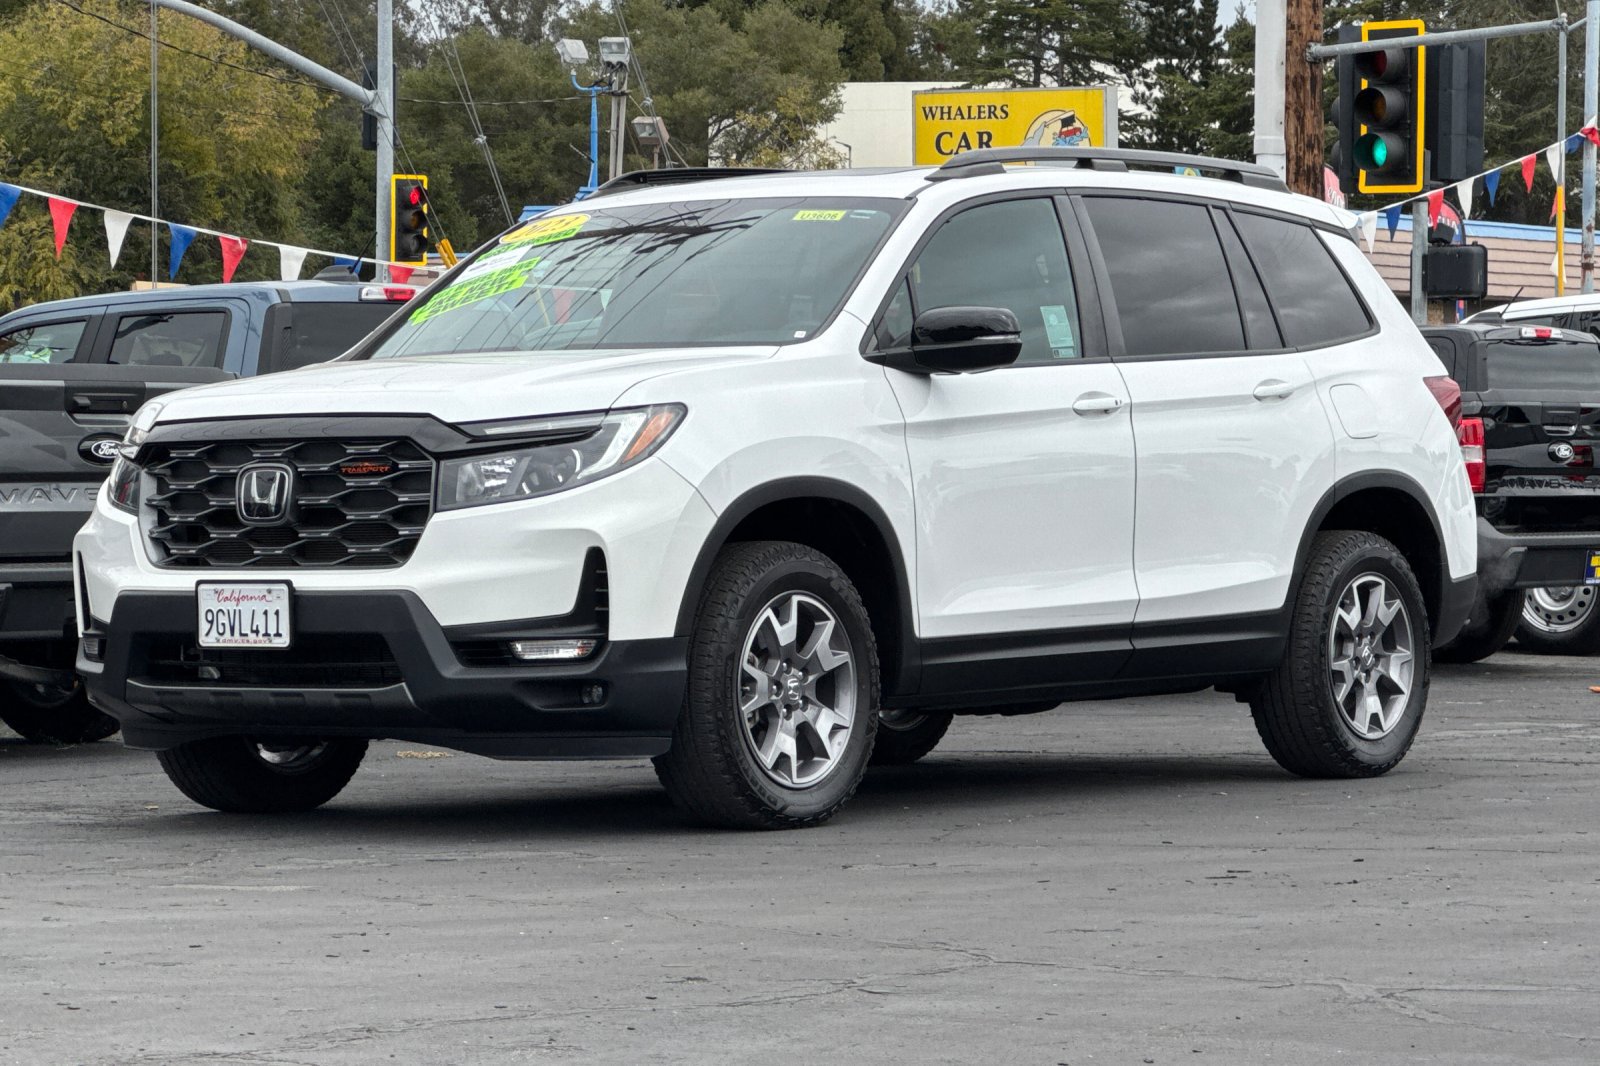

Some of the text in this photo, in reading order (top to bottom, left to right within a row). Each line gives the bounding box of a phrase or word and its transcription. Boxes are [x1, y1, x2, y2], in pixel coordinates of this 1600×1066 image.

[922, 104, 1009, 120] WHALERS
[935, 131, 993, 155] CAR
[497, 259, 537, 276] DRIVE
[424, 278, 518, 318] SWEET!
[216, 589, 272, 607] California
[205, 609, 282, 637] 9GVL411
